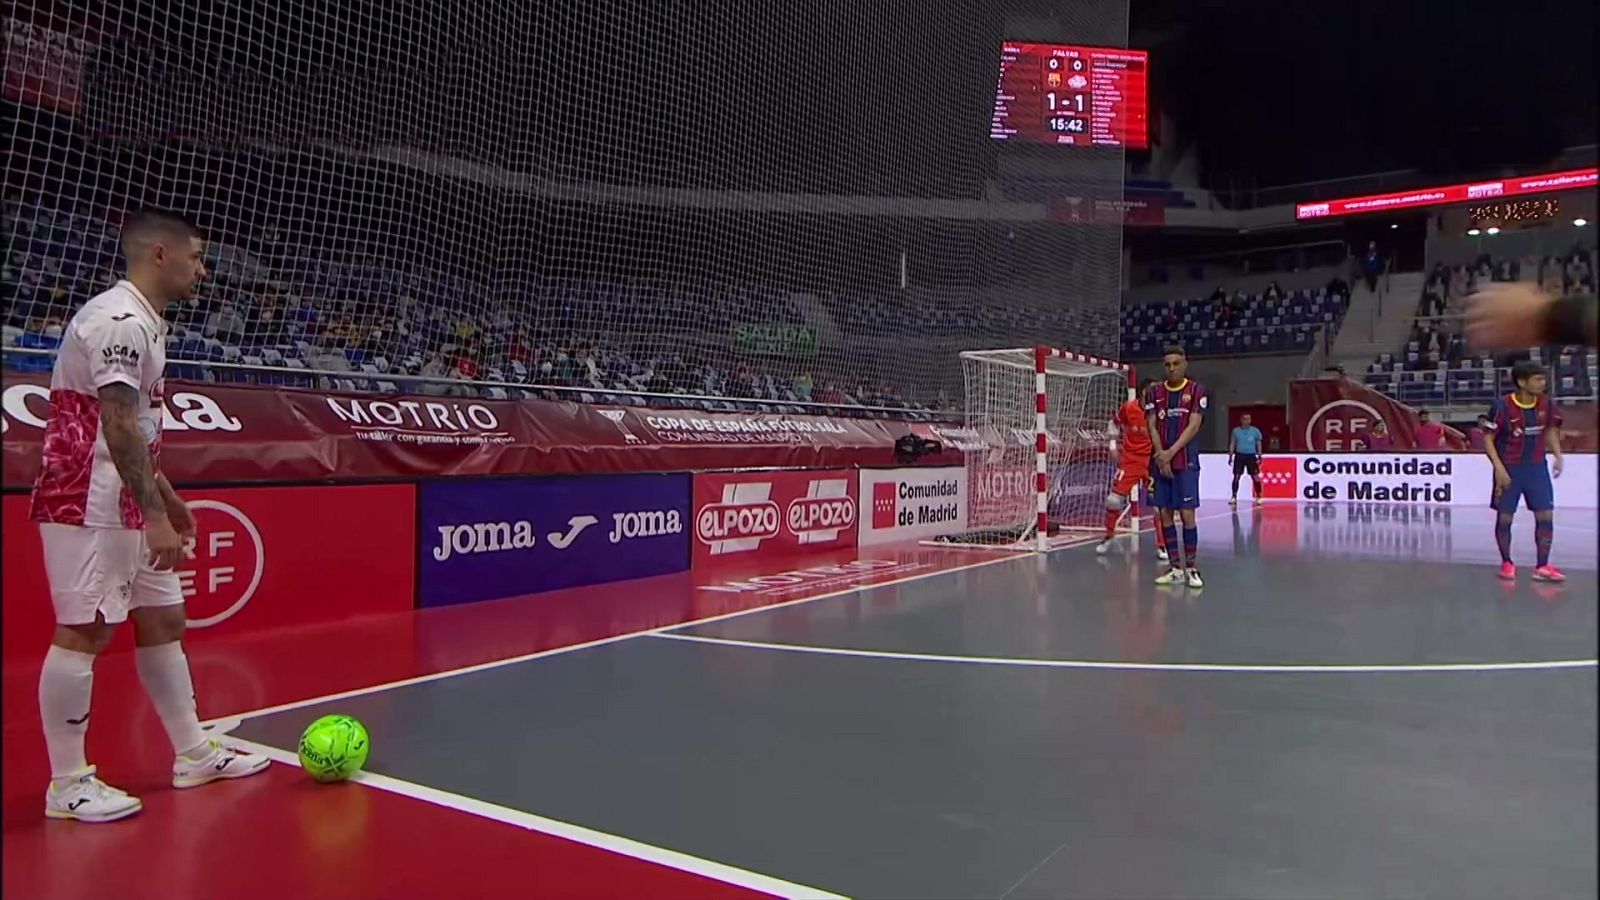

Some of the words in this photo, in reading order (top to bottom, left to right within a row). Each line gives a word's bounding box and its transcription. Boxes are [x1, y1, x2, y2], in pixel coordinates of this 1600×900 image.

[1050, 60, 1058, 69] 0
[1073, 60, 1081, 70] 0
[1047, 92, 1056, 110] 1
[1075, 94, 1083, 112] 1
[1050, 118, 1083, 131] 15:42
[102, 345, 140, 361] UCAM
[646, 416, 692, 430] COPA
[692, 418, 713, 431] DE
[716, 418, 770, 433] ESPAÑA
[770, 418, 820, 433] FÚTBOL
[818, 422, 848, 434] SALA
[397, 433, 415, 442] con
[658, 430, 739, 442] COMUNIDAD
[1303, 457, 1452, 476] Comunidad
[899, 480, 958, 499] Comunidad
[1303, 482, 1337, 500] de
[1348, 482, 1452, 502] Madrid
[898, 506, 915, 526] de
[919, 504, 958, 524] Madrid
